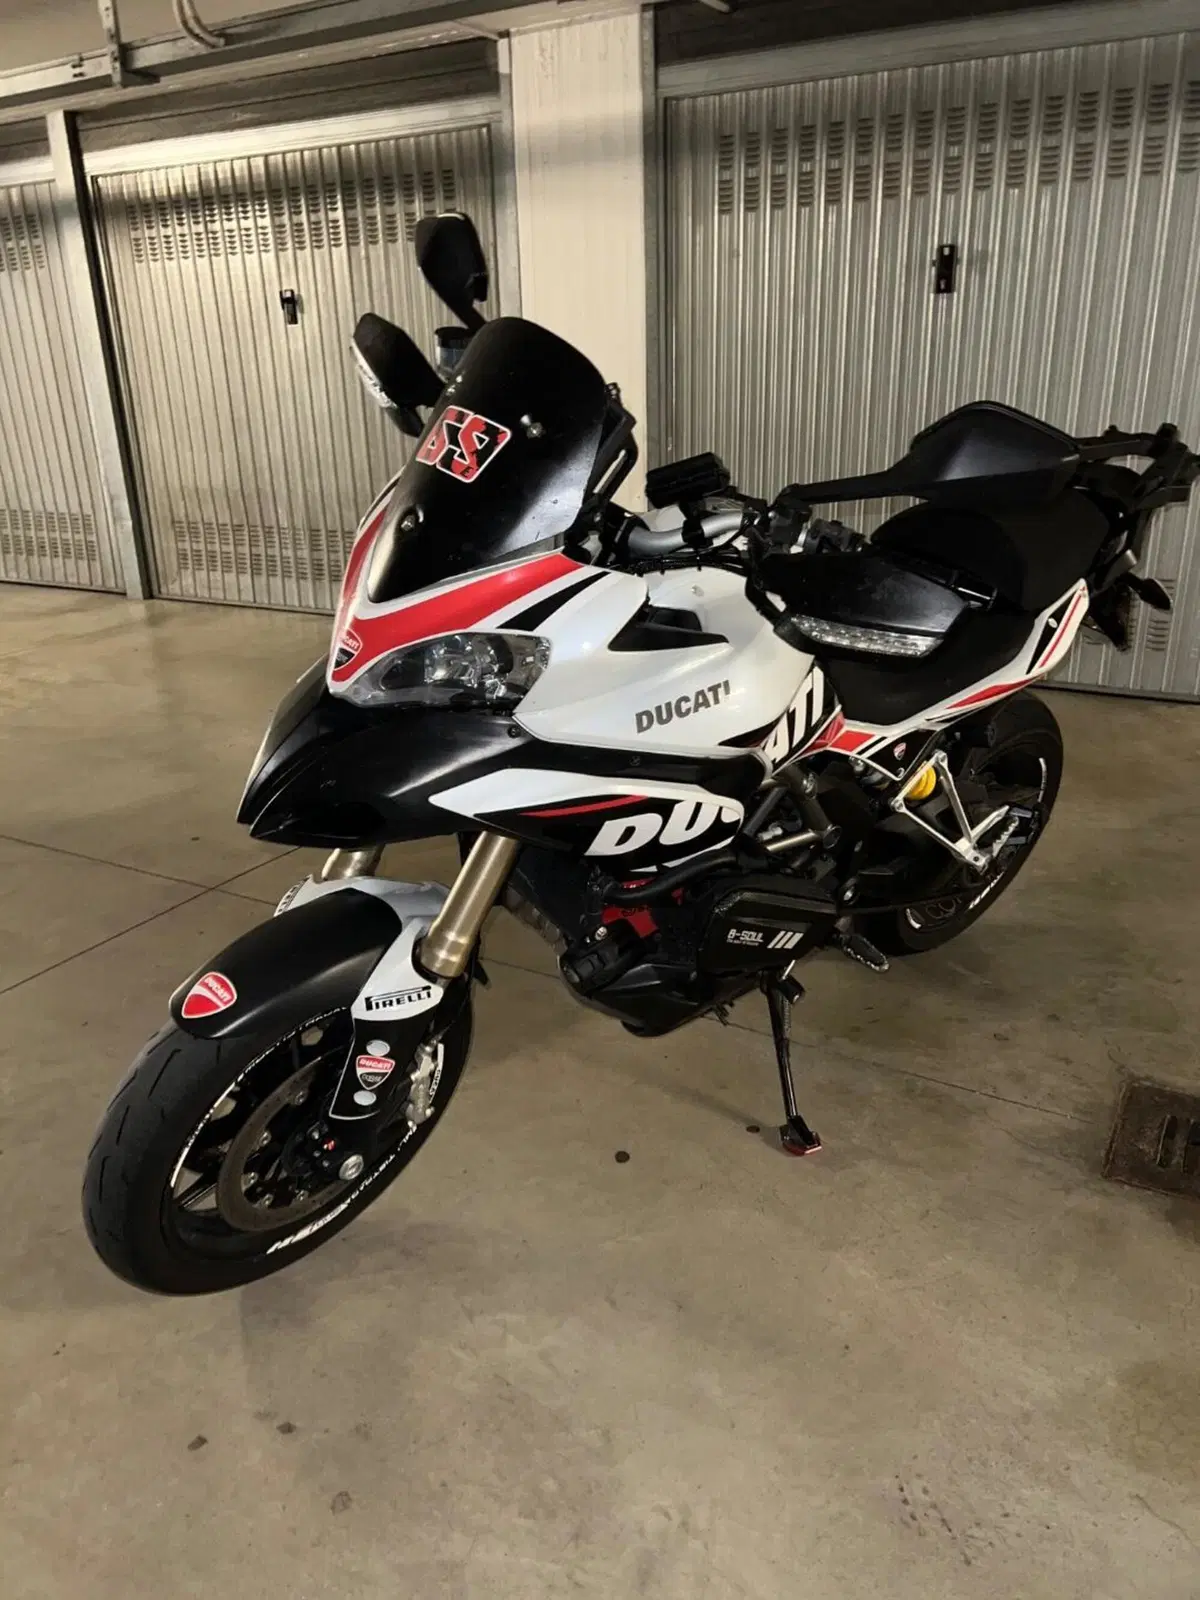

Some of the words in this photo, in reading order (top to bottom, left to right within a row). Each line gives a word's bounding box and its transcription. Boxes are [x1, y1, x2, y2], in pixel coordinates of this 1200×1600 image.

[635, 679, 730, 734] DUCATI
[764, 665, 824, 763] ATI
[365, 985, 431, 1011] PIRELLI
[358, 1058, 392, 1070] DUCATI
